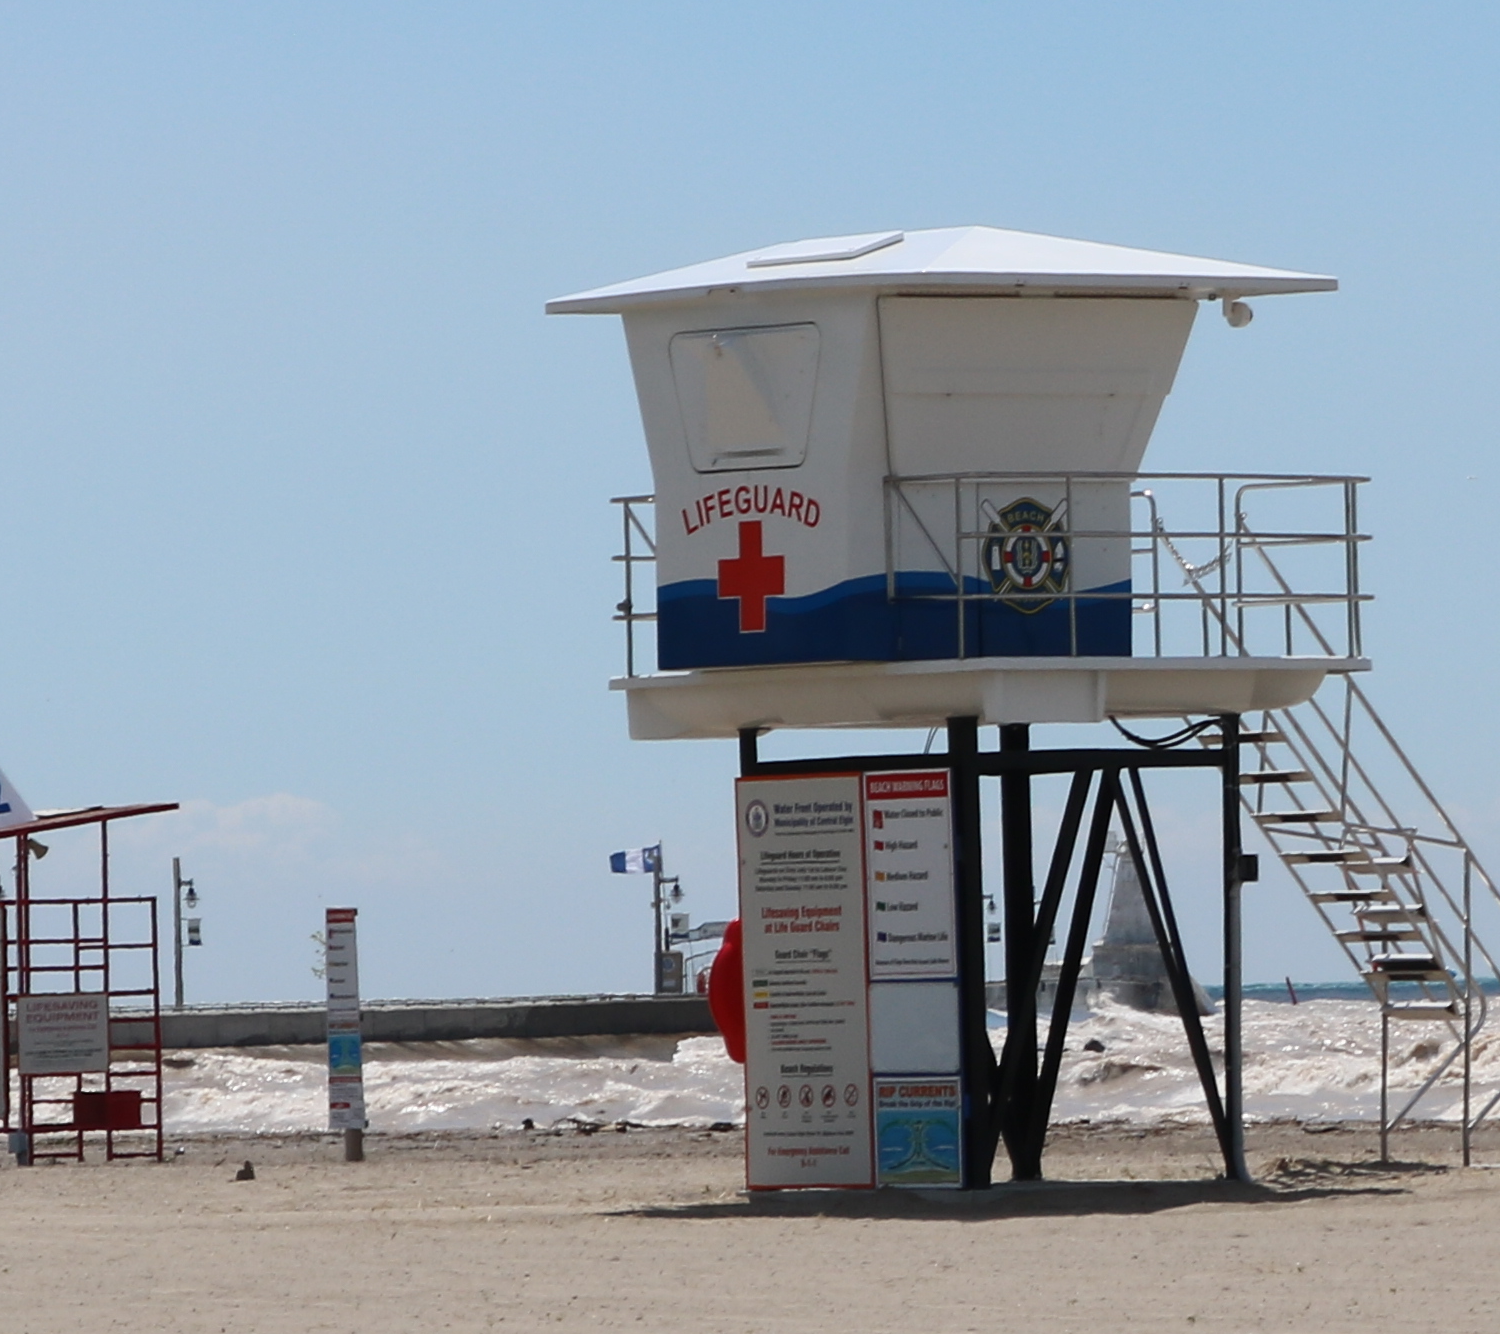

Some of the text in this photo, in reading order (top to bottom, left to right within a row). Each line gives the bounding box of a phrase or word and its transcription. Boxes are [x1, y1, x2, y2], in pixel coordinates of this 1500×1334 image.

[681, 485, 820, 536] LIFEGUARD
[1007, 511, 1045, 523] BEACH
[870, 779, 944, 793] BEACH WARNING FLAGS
[773, 801, 853, 815] Water Front Operated by
[761, 905, 841, 920] Lifesaving Equipment
[764, 920, 839, 933] at Life Guard Chairs
[26, 1000, 98, 1012] LIFESAVING
[26, 1011, 99, 1024] EQUIPMENT
[879, 1085, 957, 1098] RIP CURRENTS
